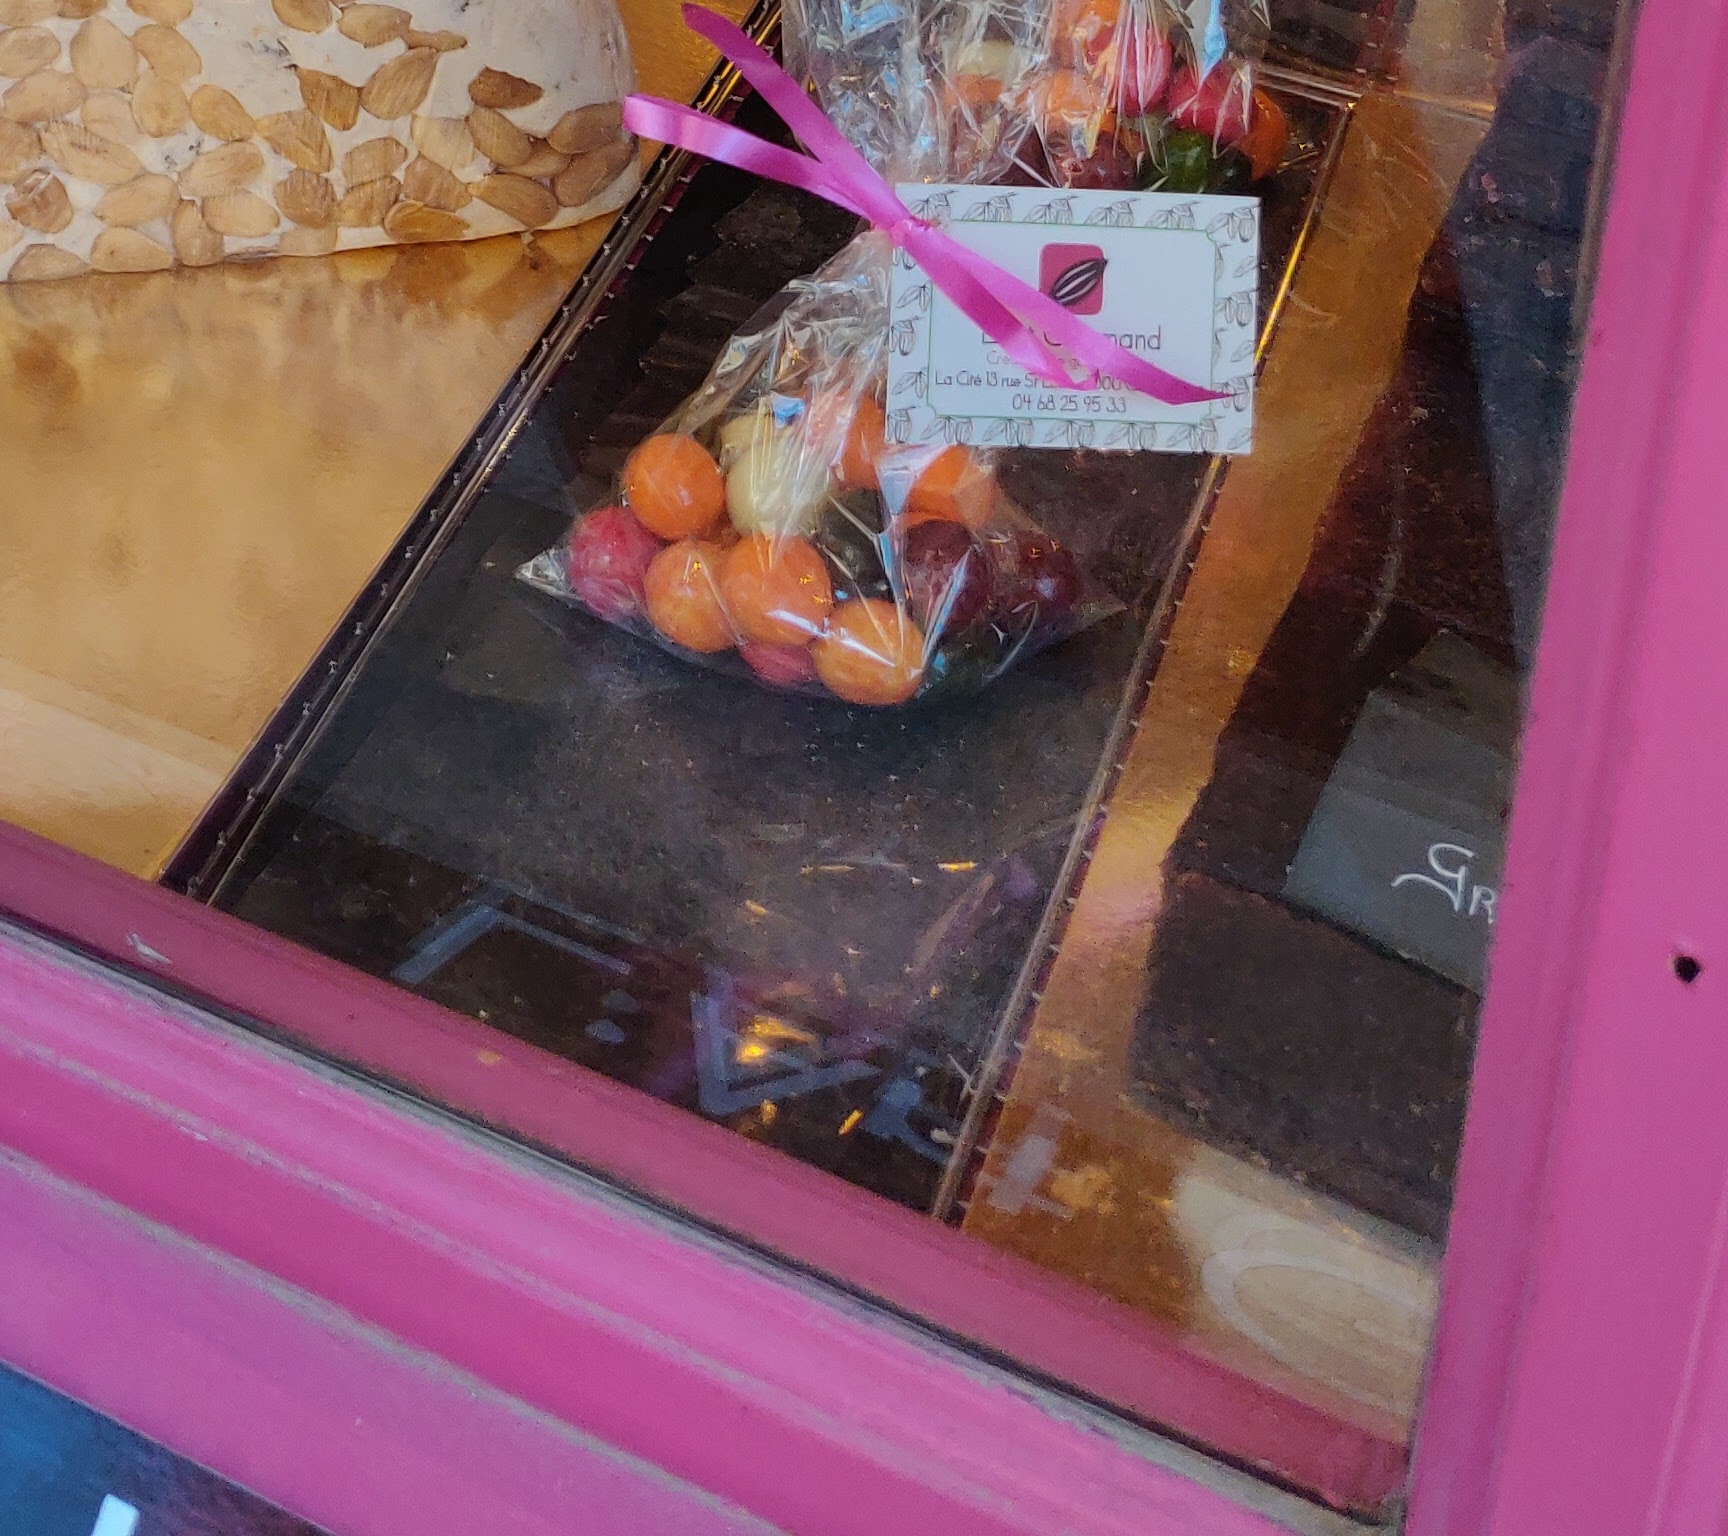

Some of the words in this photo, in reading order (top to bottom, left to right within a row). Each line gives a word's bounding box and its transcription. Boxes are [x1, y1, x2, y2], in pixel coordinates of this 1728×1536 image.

[935, 370, 953, 385] La
[1001, 376, 1022, 388] rue
[1012, 393, 1031, 410] 04
[1037, 393, 1055, 411] 68
[1060, 394, 1078, 412] 25
[1083, 395, 1101, 413] 95
[1106, 396, 1127, 413] 33
